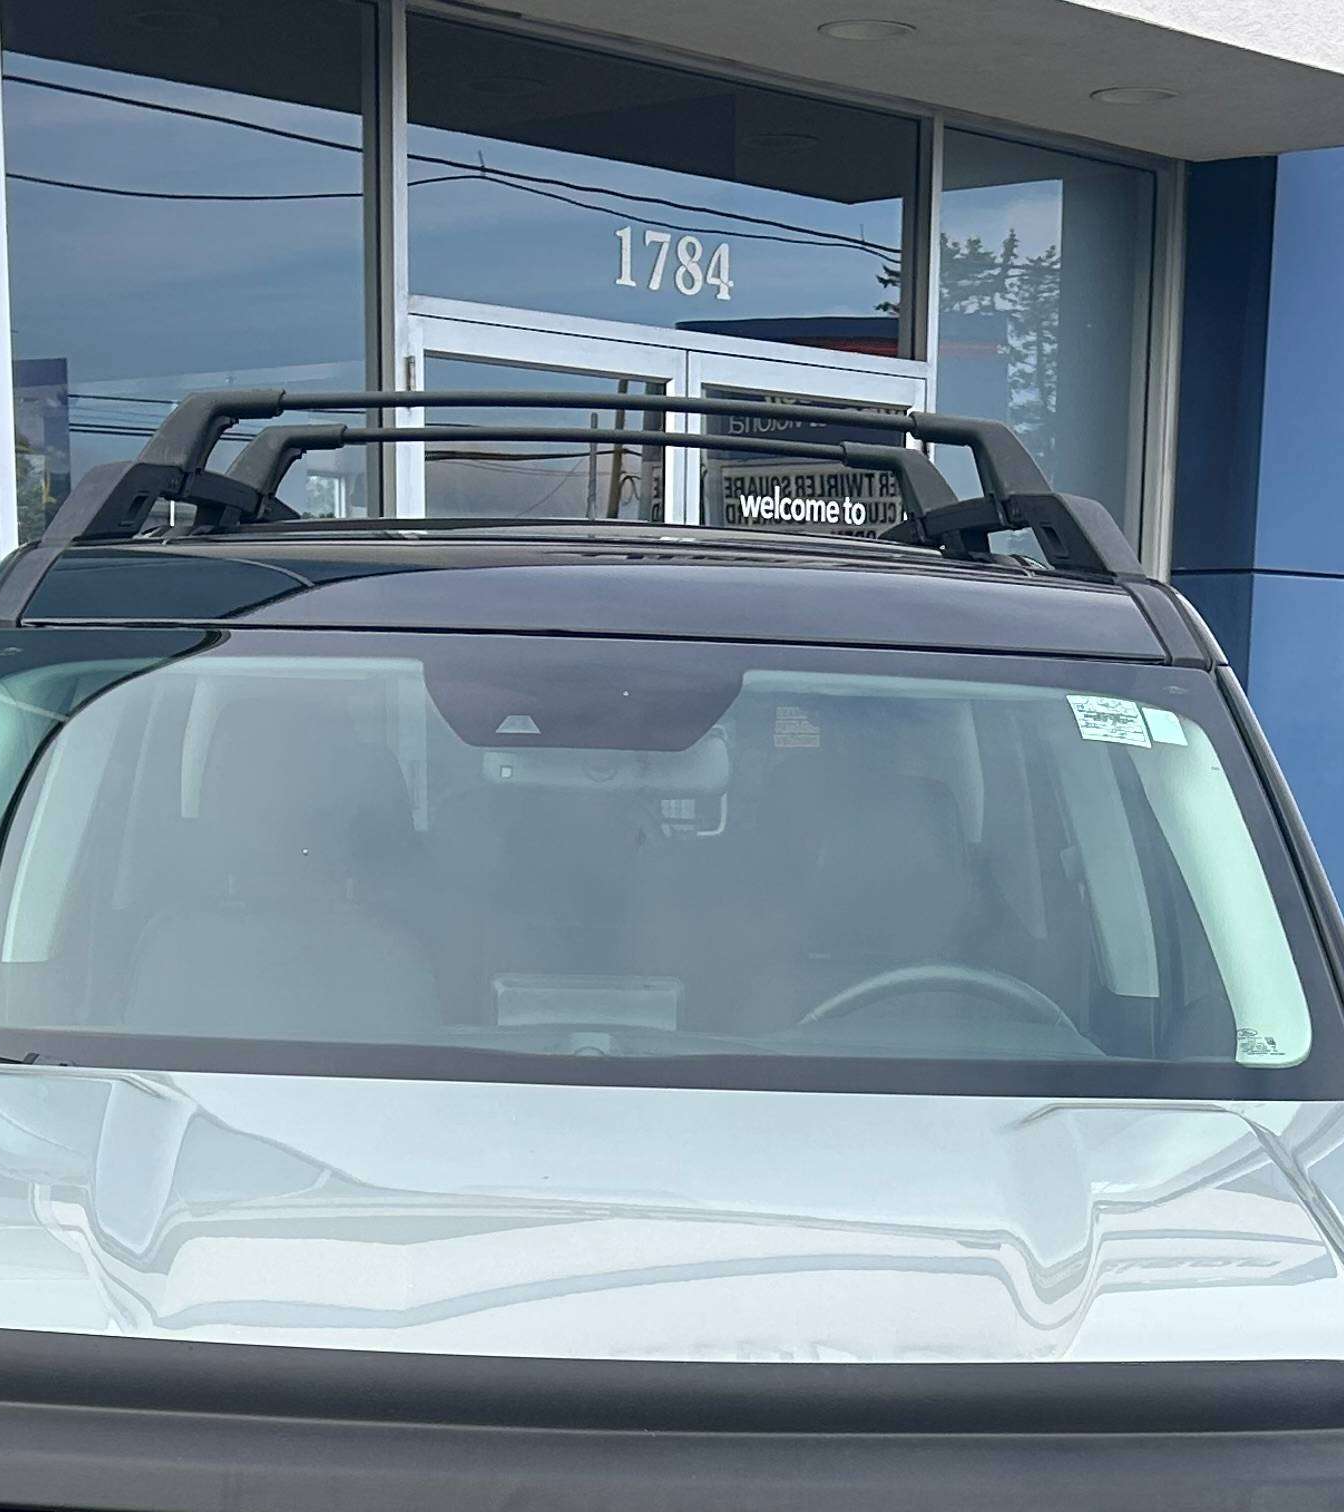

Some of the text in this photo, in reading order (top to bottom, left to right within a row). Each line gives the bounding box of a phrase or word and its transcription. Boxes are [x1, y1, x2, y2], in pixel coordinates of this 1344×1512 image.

[615, 226, 735, 300] 1784
[740, 486, 840, 523] welcome
[843, 497, 866, 525] to
